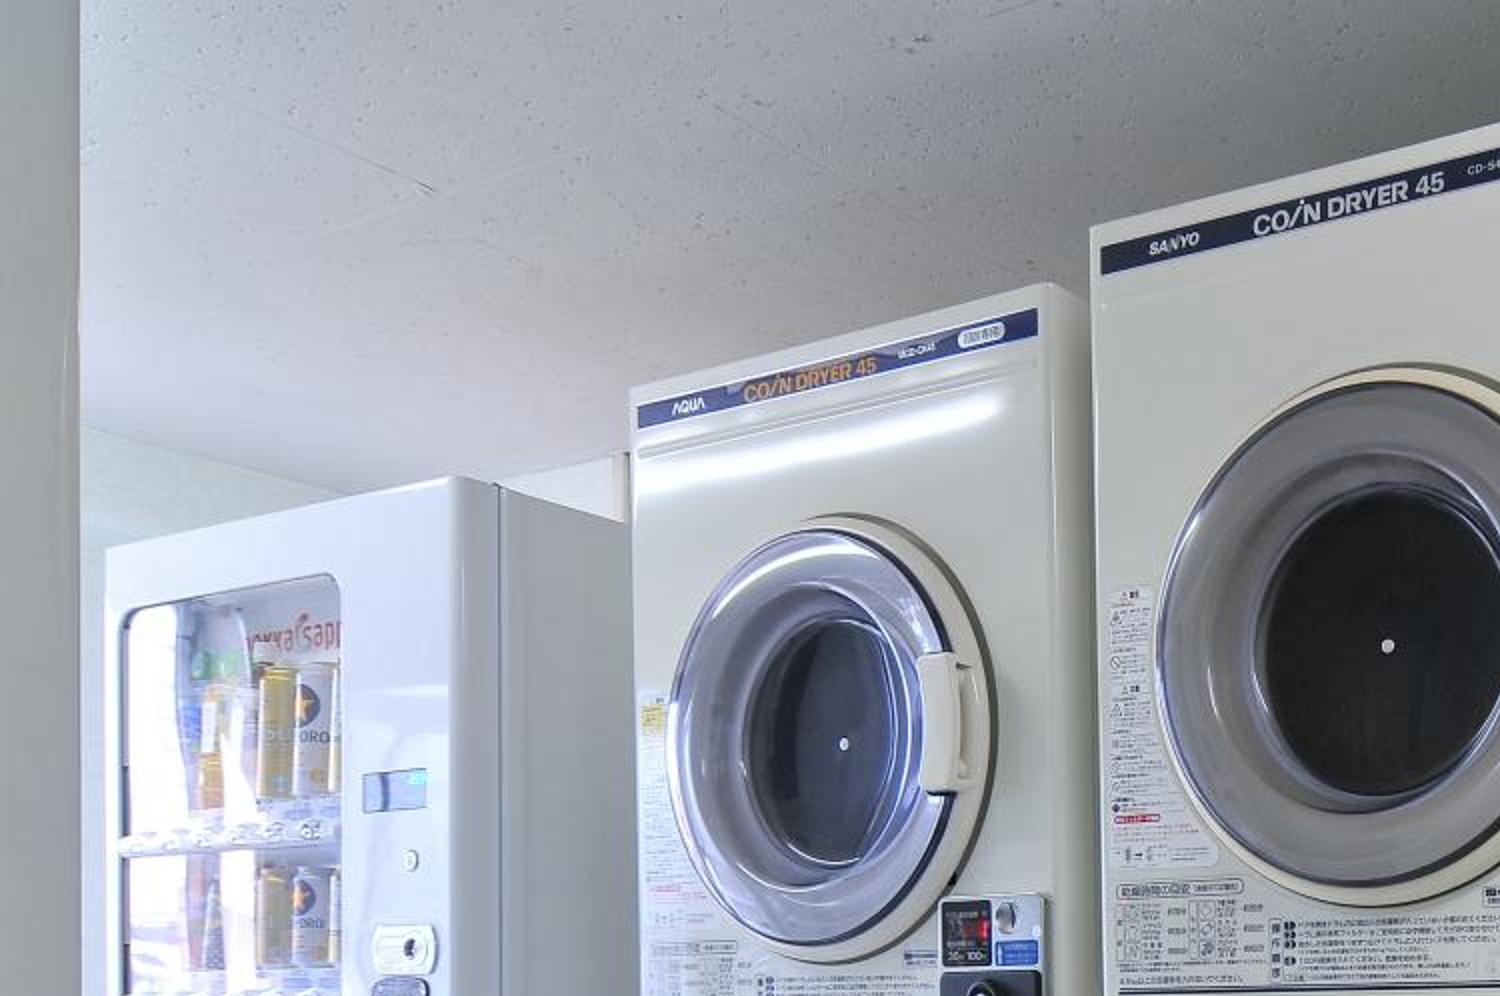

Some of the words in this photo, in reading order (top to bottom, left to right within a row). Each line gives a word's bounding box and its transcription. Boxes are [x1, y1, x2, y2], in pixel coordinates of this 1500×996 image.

[1147, 231, 1200, 257] SANYO
[1327, 179, 1409, 219] DRYER
[1414, 170, 1445, 196] 45
[671, 396, 706, 416] AQUA
[798, 361, 851, 392] DRYER
[855, 357, 877, 376] 45
